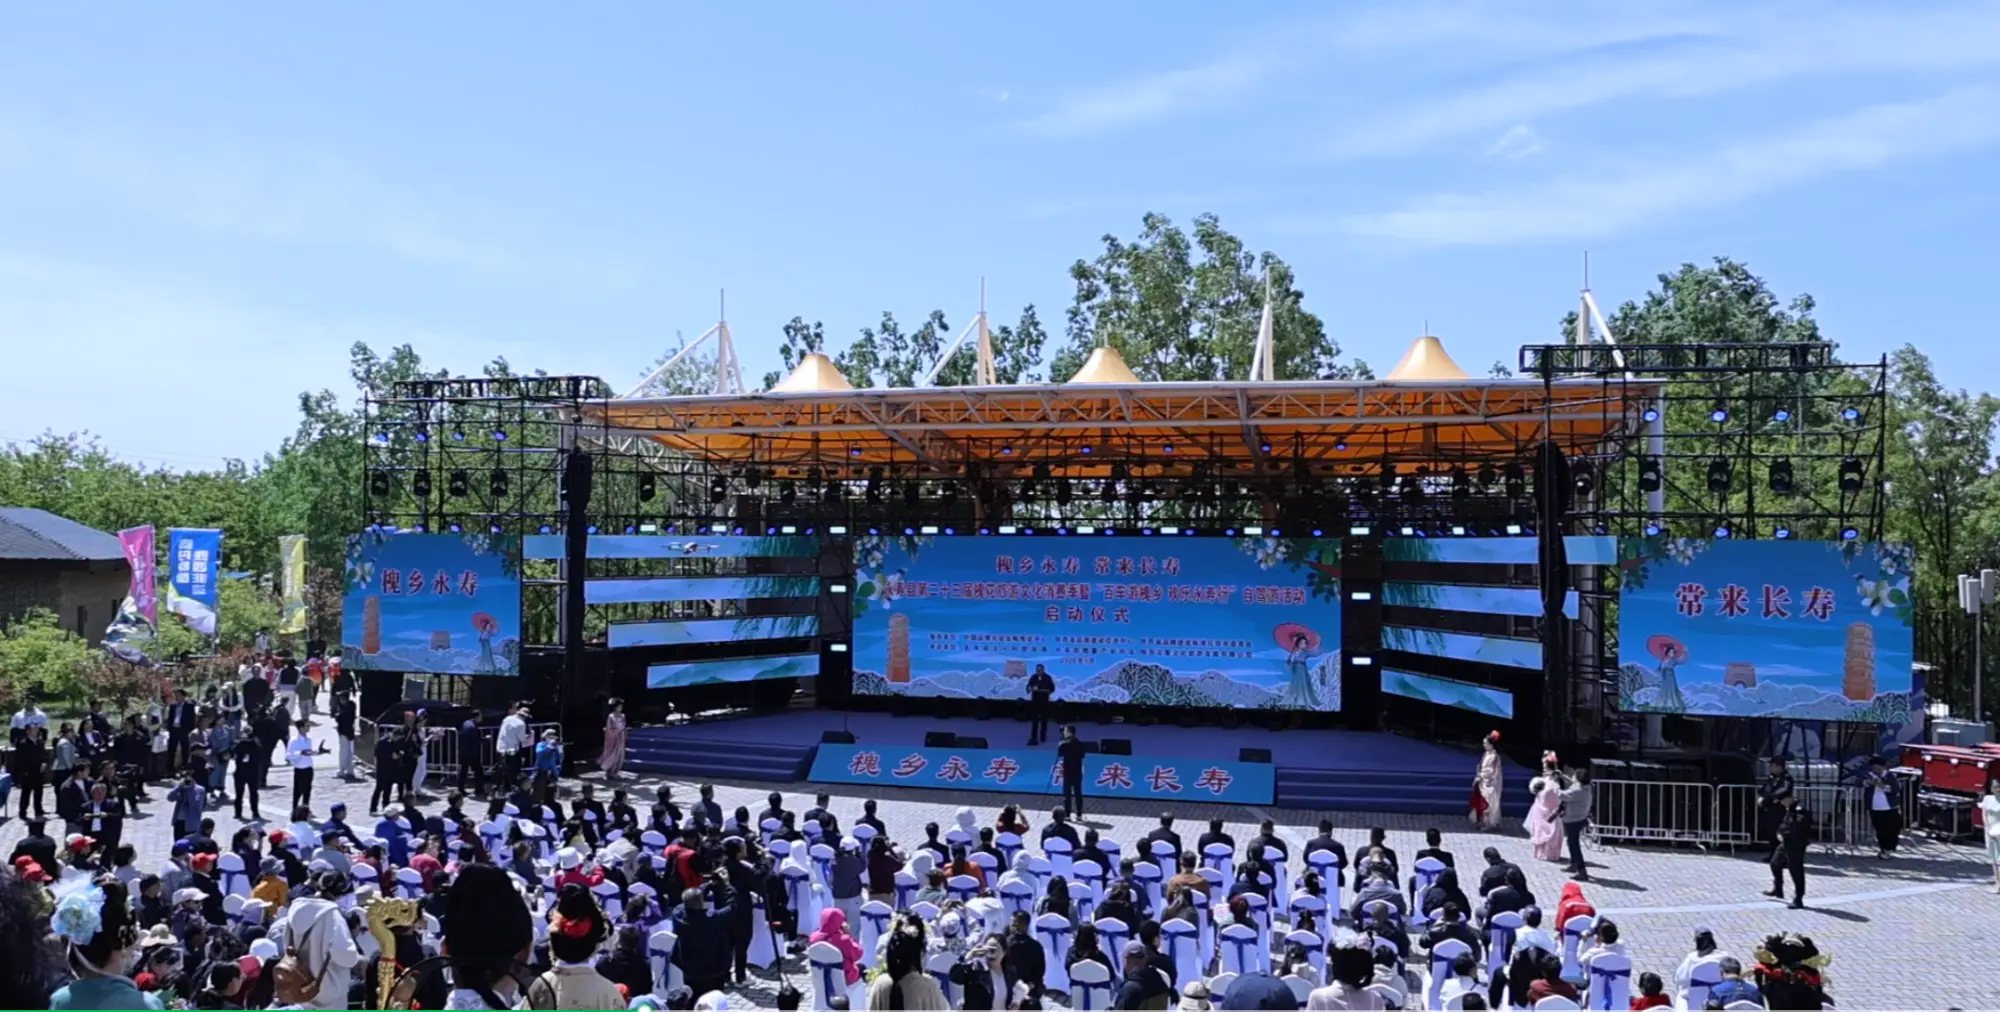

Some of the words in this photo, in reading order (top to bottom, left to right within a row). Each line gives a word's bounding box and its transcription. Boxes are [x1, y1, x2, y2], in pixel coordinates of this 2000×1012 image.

[996, 556, 1081, 574] 槐乡永寿
[1094, 556, 1181, 576] 常来长寿
[381, 568, 479, 597] 槐乡永寿
[1044, 606, 1130, 624] 启动仪式
[1674, 582, 1836, 621] 常来长寿
[848, 752, 1020, 785] 槐乡永寿
